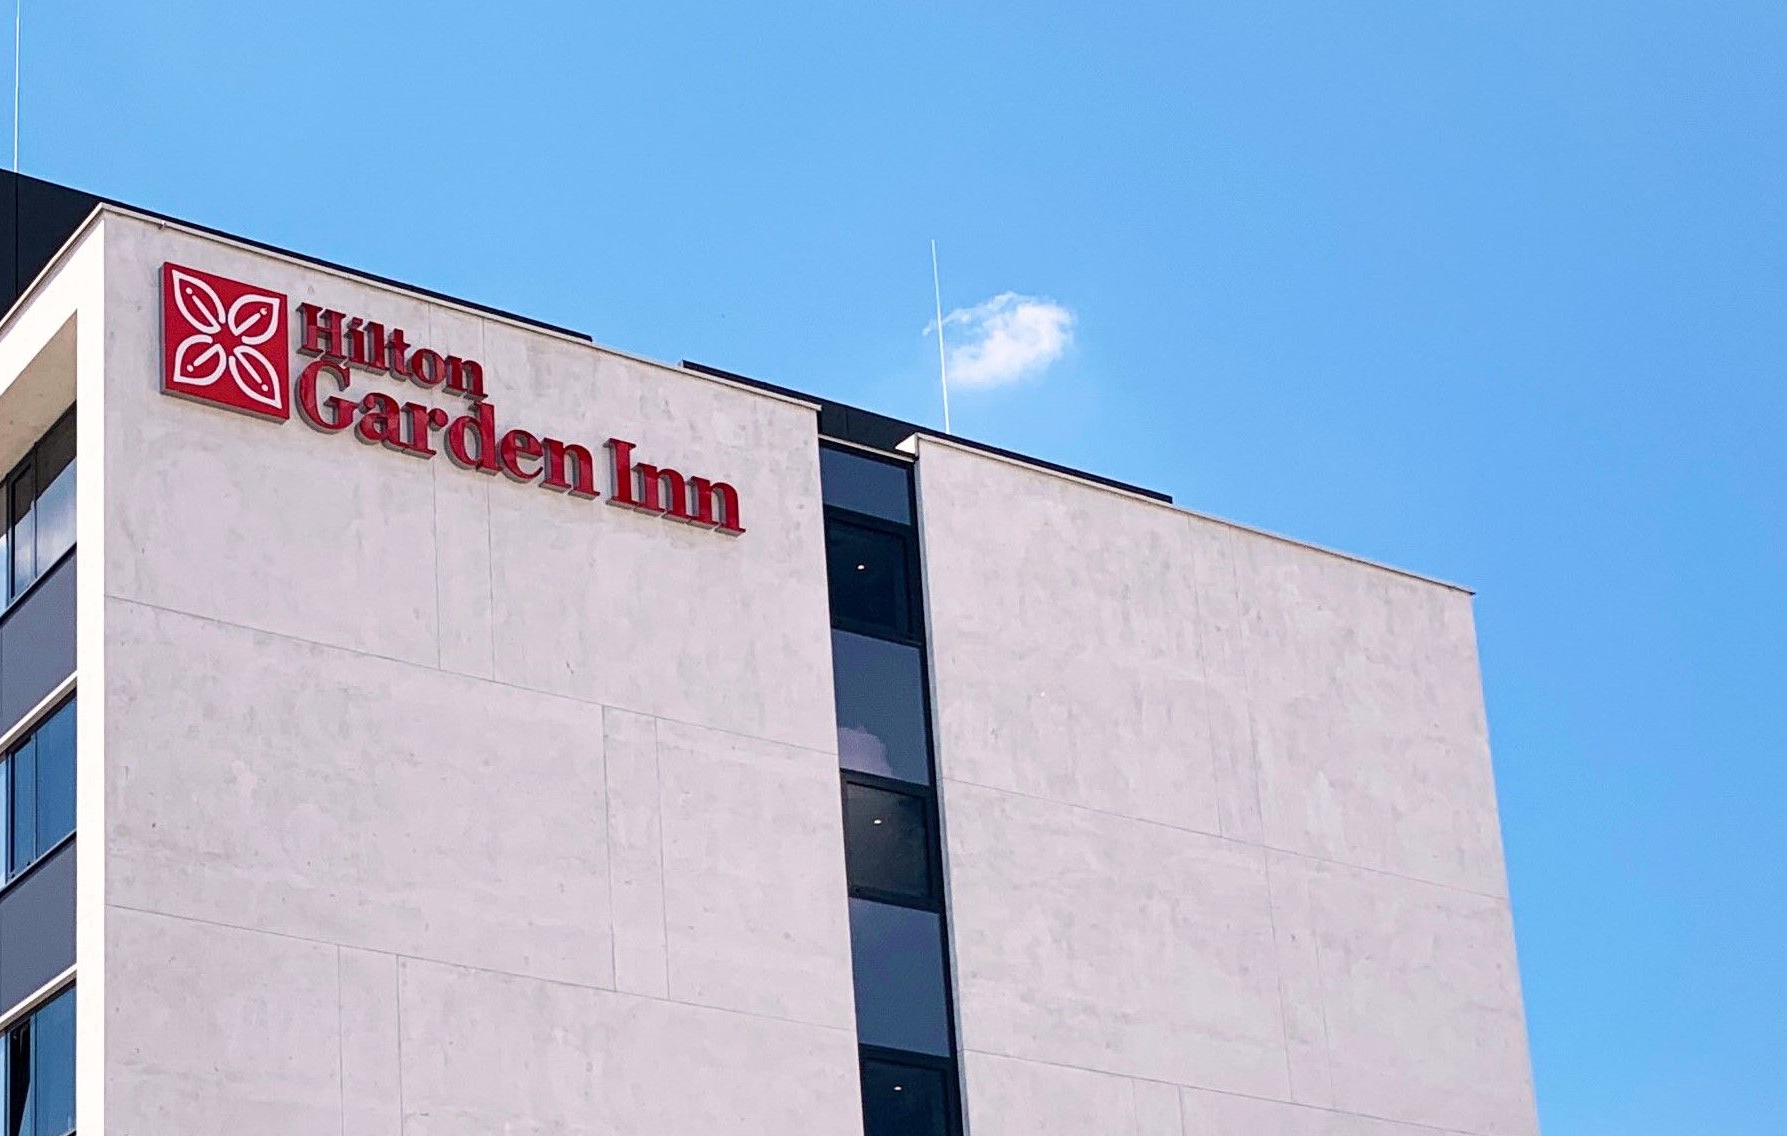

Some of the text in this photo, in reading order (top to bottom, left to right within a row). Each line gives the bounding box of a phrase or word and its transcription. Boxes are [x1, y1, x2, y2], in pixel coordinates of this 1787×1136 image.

[295, 302, 488, 399] Hilton
[294, 359, 746, 536] Garden Inn
